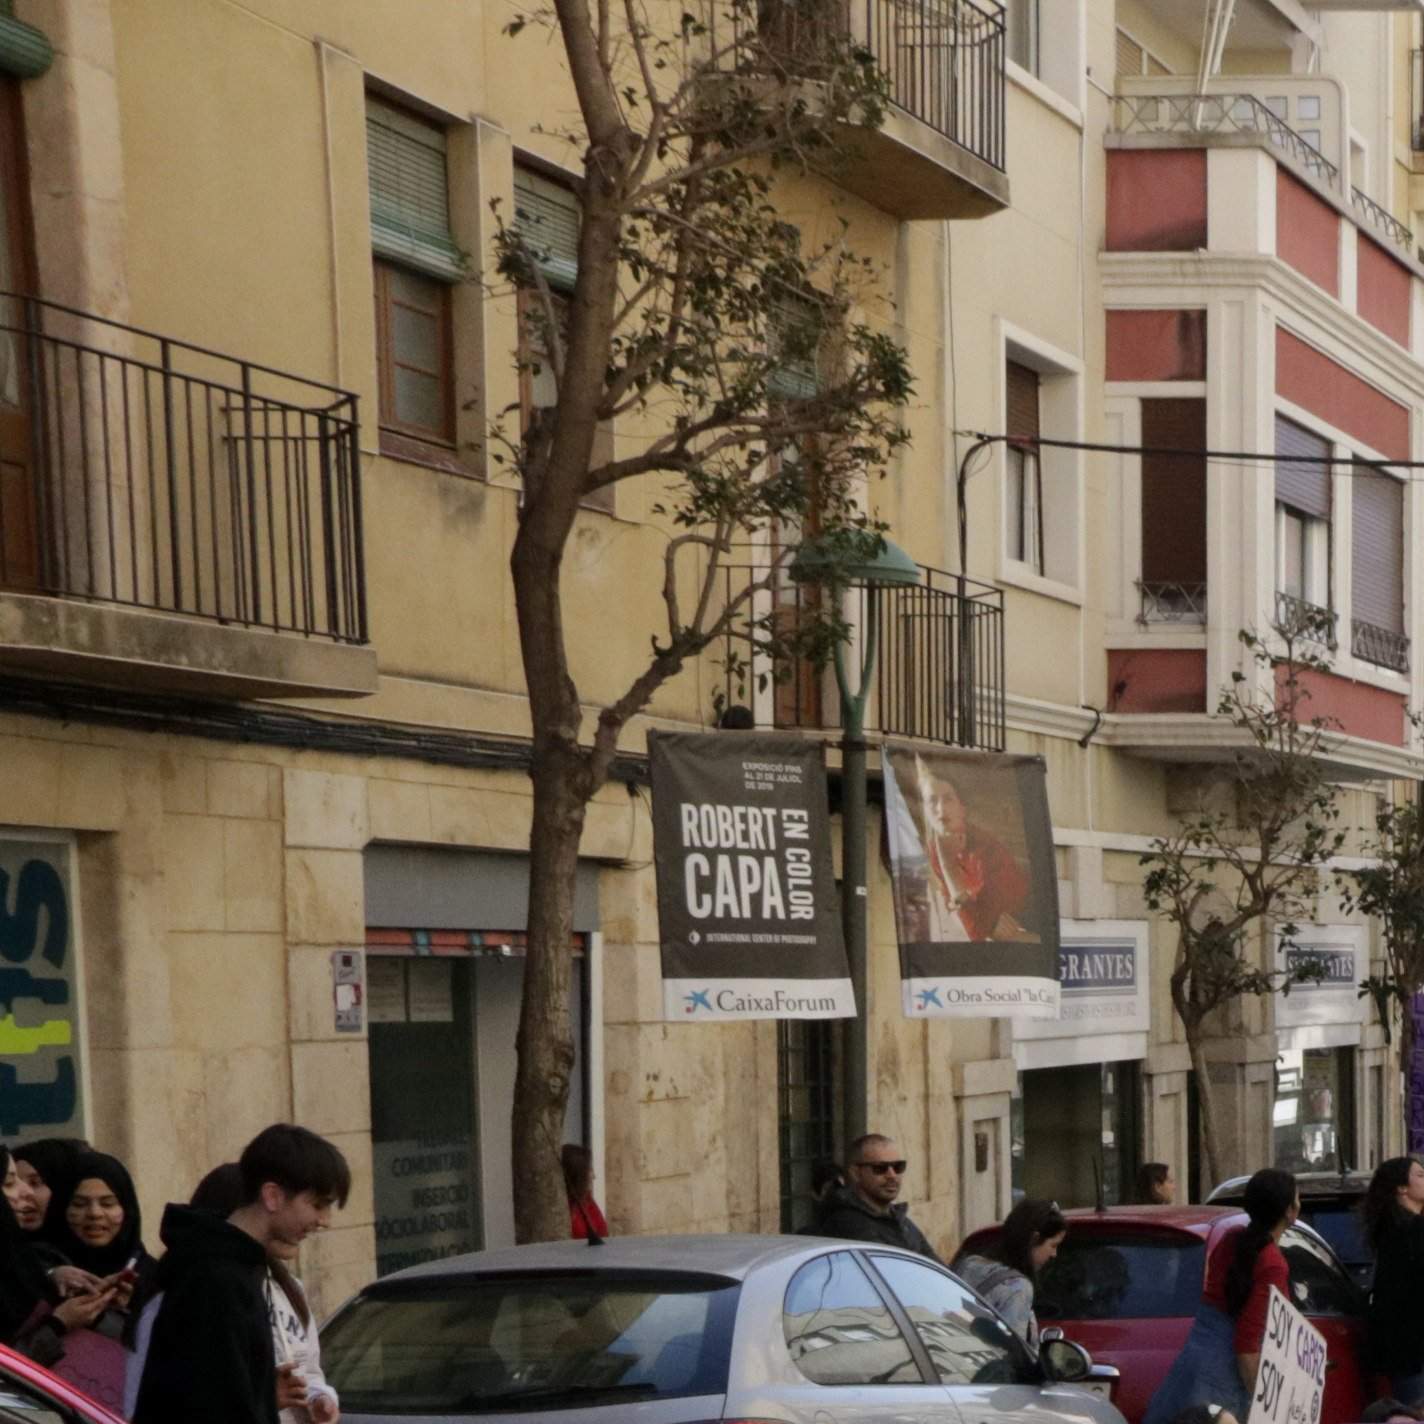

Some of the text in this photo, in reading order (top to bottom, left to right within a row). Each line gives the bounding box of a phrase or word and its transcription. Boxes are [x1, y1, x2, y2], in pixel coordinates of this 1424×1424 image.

[681, 803, 776, 850] ROBERT
[685, 853, 785, 920] CAPA
[782, 808, 814, 920] EN COLOR
[716, 990, 835, 1013] CaixaForum
[947, 989, 982, 1004] Obra
[984, 987, 1020, 1003] Social
[1269, 1295, 1325, 1387] SOY CAPAZ
[1257, 1359, 1284, 1422] SOY
